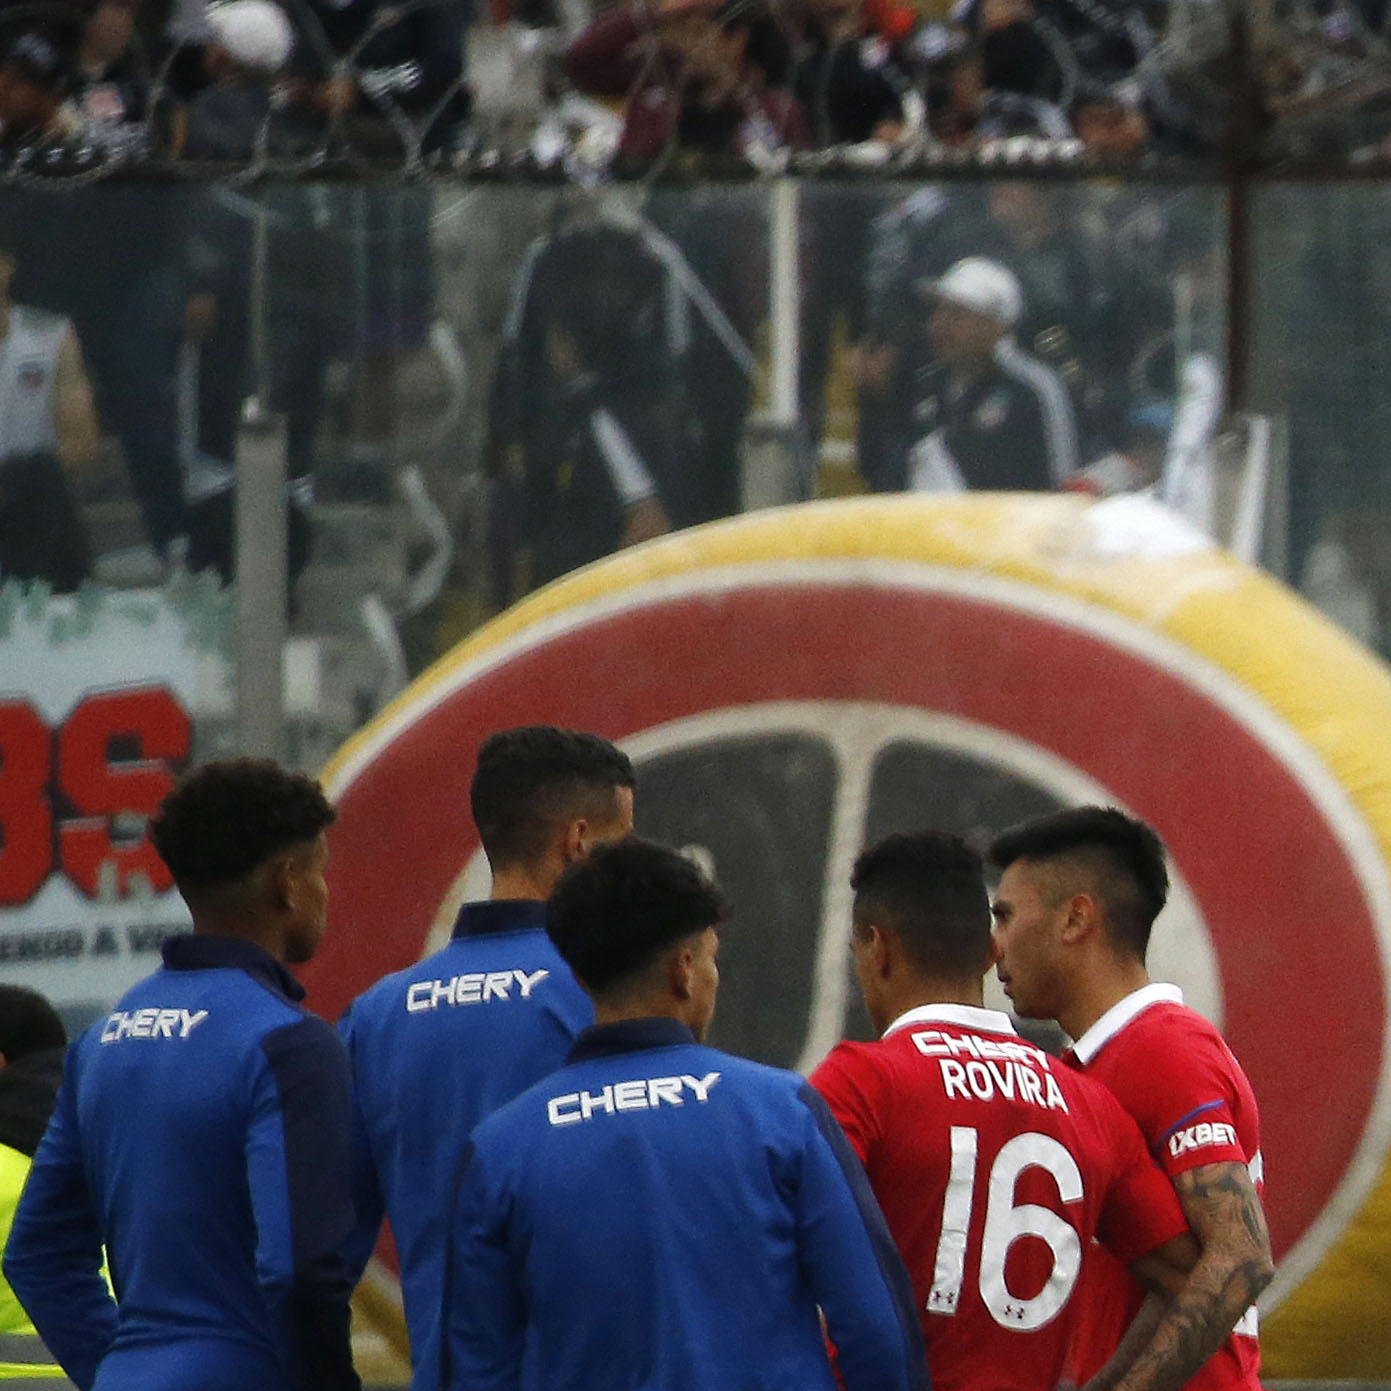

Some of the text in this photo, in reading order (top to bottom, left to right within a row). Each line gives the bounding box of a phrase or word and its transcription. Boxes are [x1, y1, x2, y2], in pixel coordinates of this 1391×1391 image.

[406, 970, 549, 1014] CHERY
[101, 1009, 208, 1044] CHERY
[911, 1031, 1050, 1071] CHERY
[547, 1072, 722, 1127] CHERY
[939, 1059, 1070, 1116] ROVIRA
[926, 1125, 1084, 1332] 16
